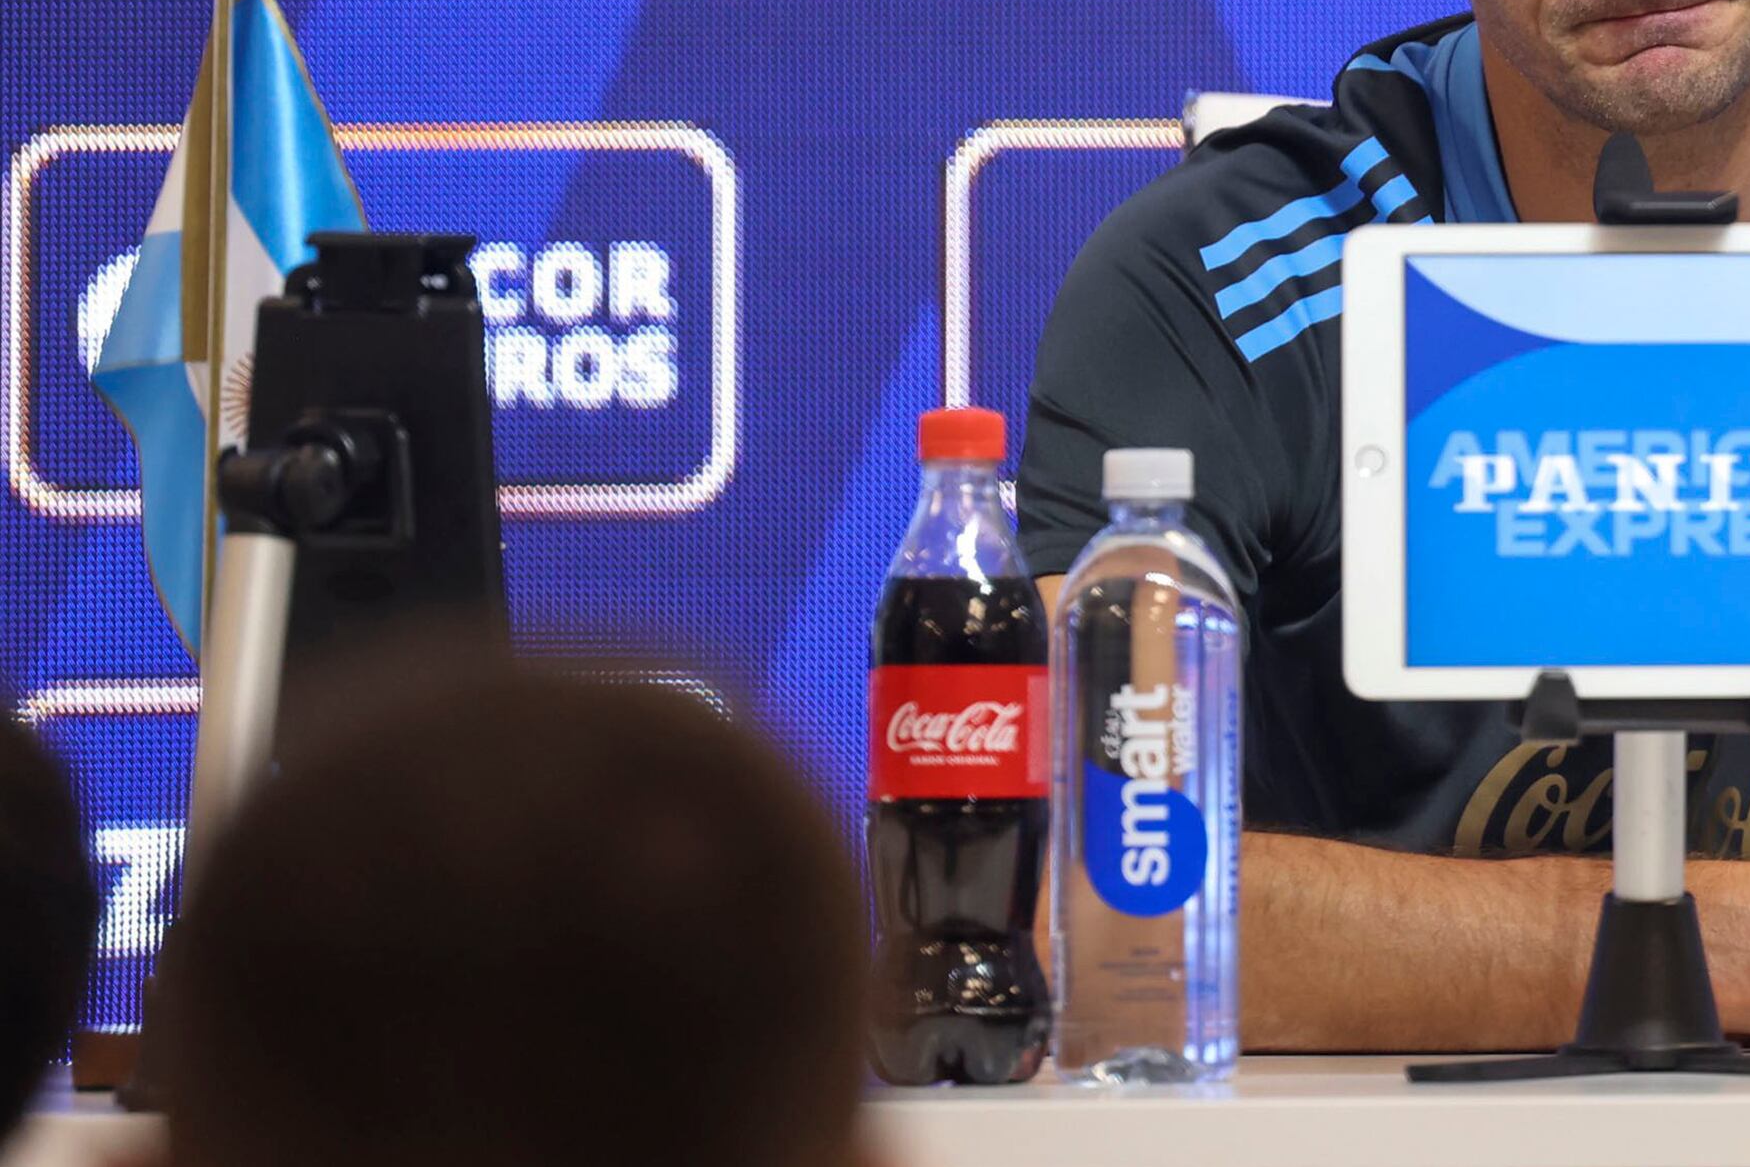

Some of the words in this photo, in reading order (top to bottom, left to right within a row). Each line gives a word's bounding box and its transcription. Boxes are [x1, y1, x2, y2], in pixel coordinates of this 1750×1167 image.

[467, 241, 678, 324] COR
[485, 325, 678, 410] ROS
[886, 701, 1024, 753] Coca-Cola
[1171, 684, 1197, 775] water
[1110, 683, 1170, 886] smart
